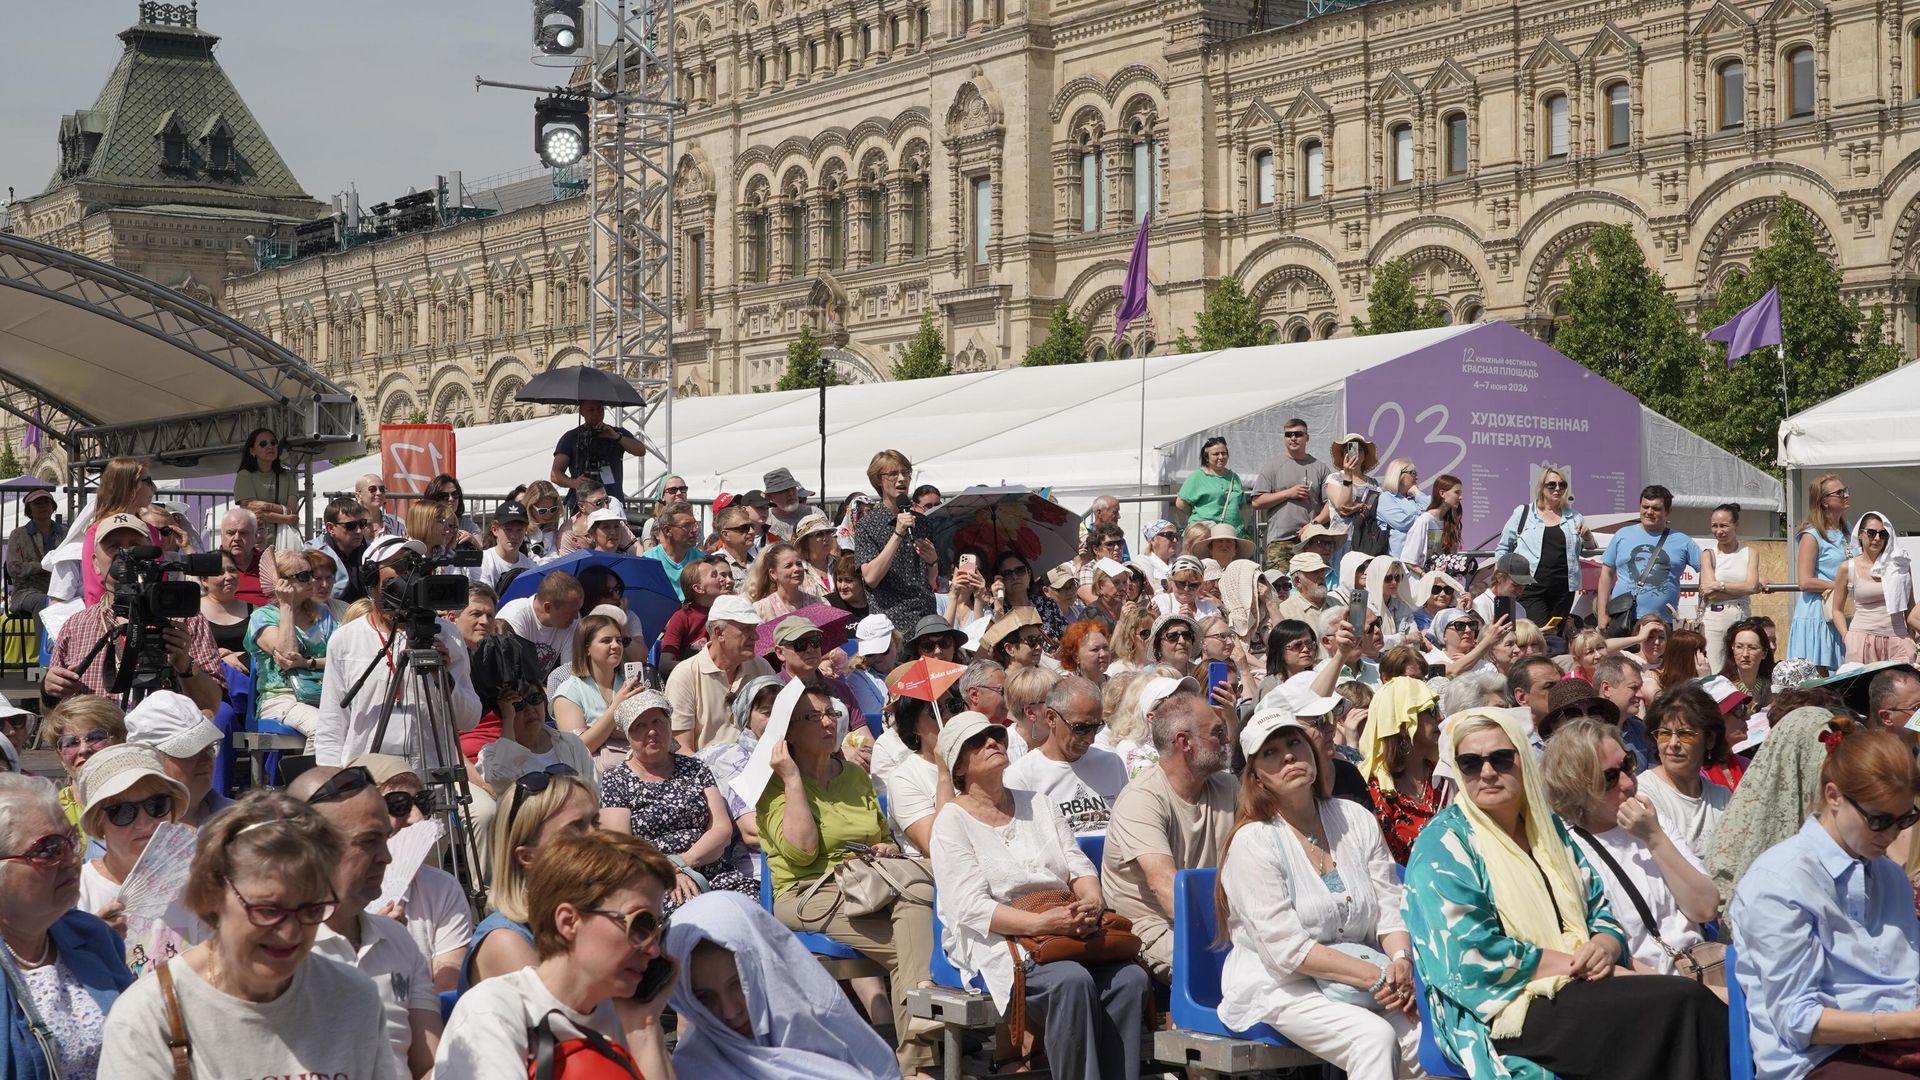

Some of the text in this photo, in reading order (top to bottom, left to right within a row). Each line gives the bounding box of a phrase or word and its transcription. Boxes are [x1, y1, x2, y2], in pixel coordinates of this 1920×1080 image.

[1462, 347, 1475, 363] 12
[1462, 364, 1539, 379] КРАСНАЯ ПЛОЩАДЬ
[1508, 383, 1528, 393] 2026
[1471, 412, 1590, 432] ХУДОЖЕСТВЕННАЯ
[1368, 401, 1467, 490] 23
[1471, 431, 1552, 449] ЛИТЕРАТУРА
[1059, 795, 1106, 816] RBAN
